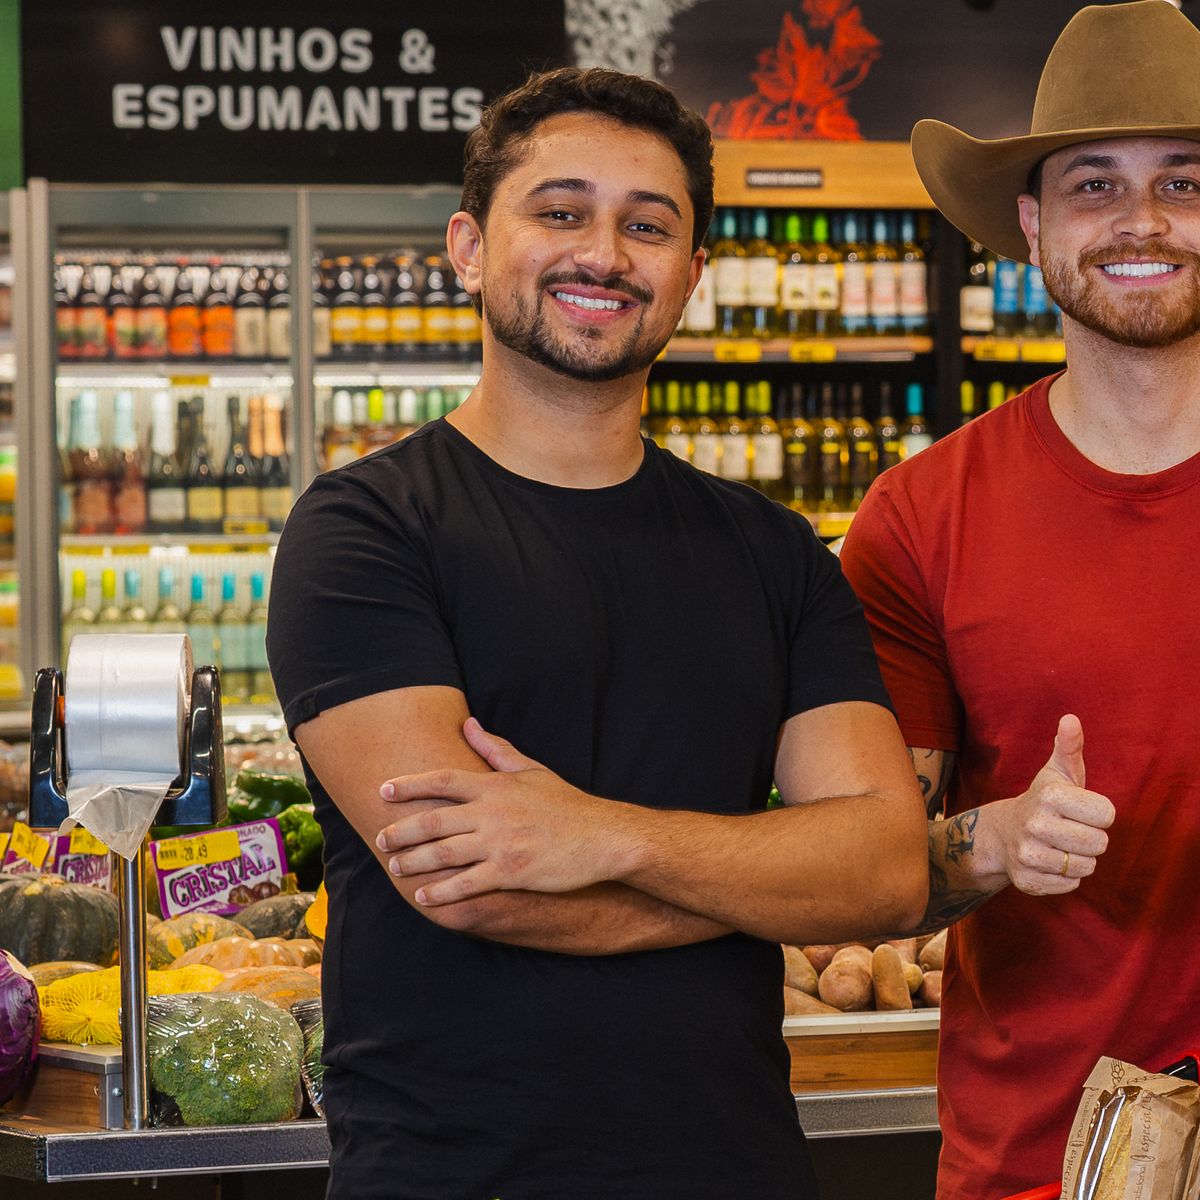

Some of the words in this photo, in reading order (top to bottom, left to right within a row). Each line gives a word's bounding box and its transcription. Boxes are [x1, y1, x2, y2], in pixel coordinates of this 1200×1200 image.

[160, 26, 373, 73] VINHOS
[399, 28, 436, 74] &
[112, 84, 484, 132] ESPUMANTES
[169, 843, 277, 907] CRISTAL
[1139, 1104, 1156, 1154] especial
